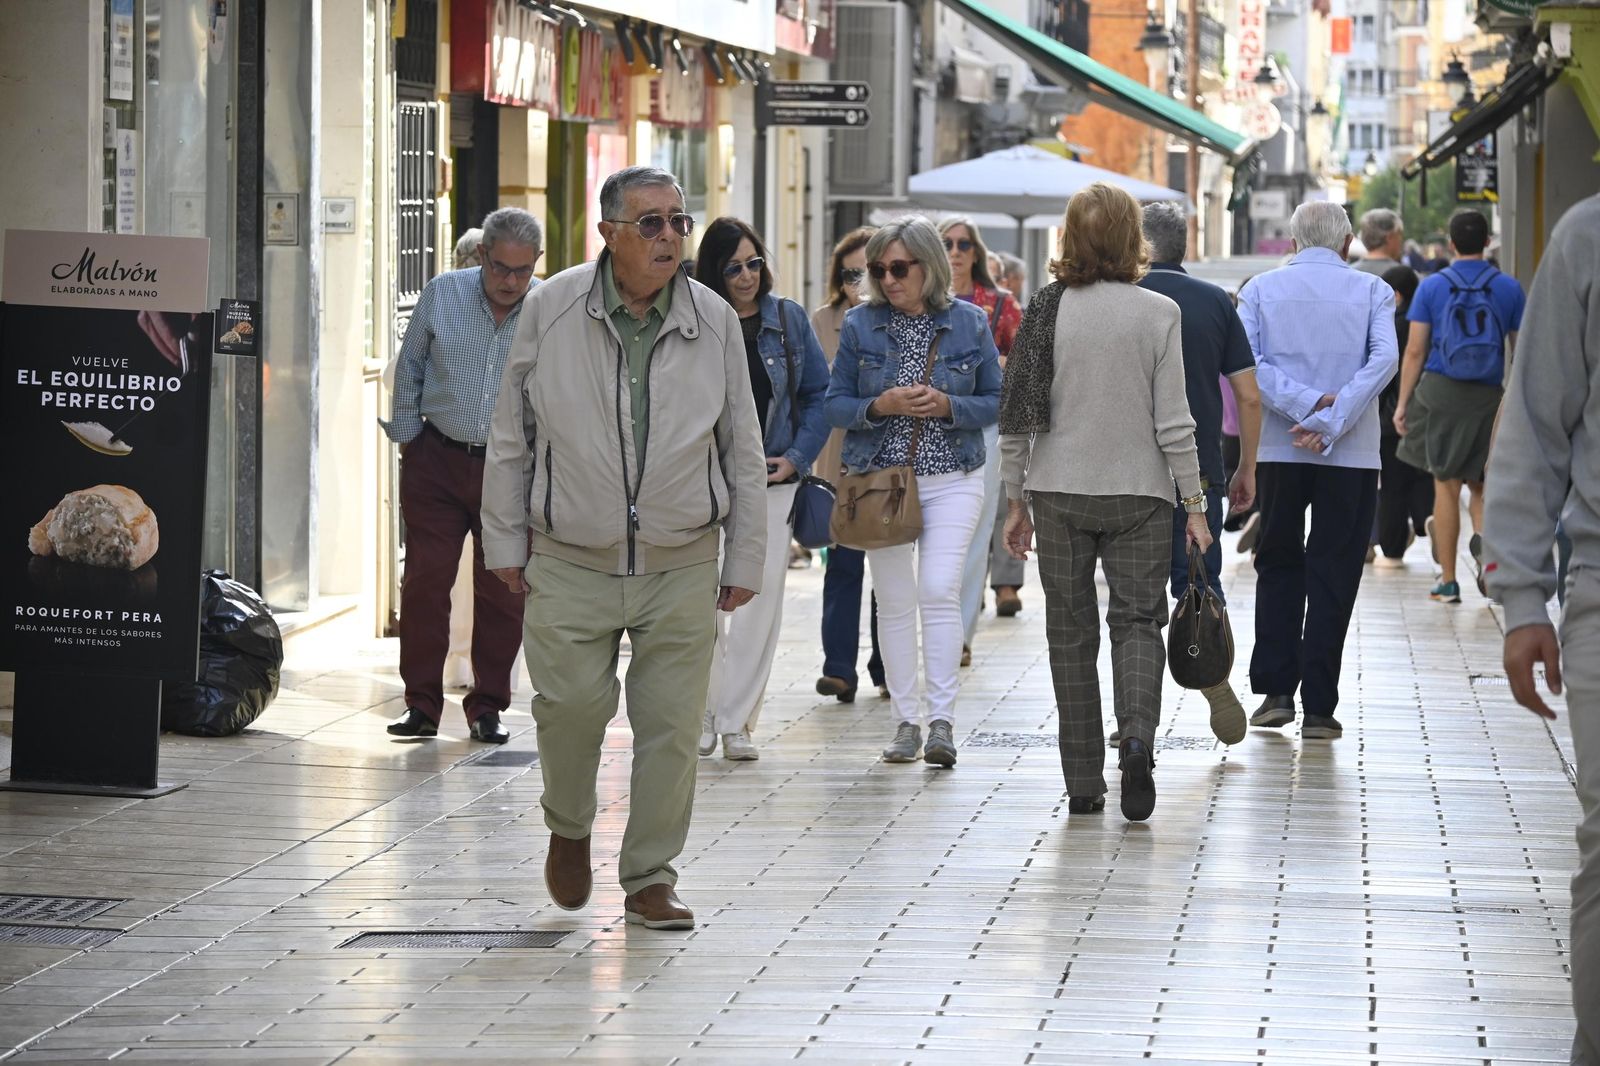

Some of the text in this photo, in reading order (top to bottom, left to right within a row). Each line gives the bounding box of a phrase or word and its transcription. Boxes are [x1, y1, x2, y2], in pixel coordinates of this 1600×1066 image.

[51, 247, 157, 285] Malvón
[51, 286, 116, 296] ELABORADAS
[129, 290, 158, 298] MANO
[72, 356, 129, 369] VUELVE
[17, 369, 182, 392] EL EQUILIBRIO
[41, 391, 156, 412] PERFECTO
[15, 606, 162, 623] ROQUEFORT PERA
[14, 623, 37, 632] PARA
[40, 625, 83, 634] AMANTES
[121, 630, 162, 639] SABORES
[76, 638, 121, 647] INTENSOS
